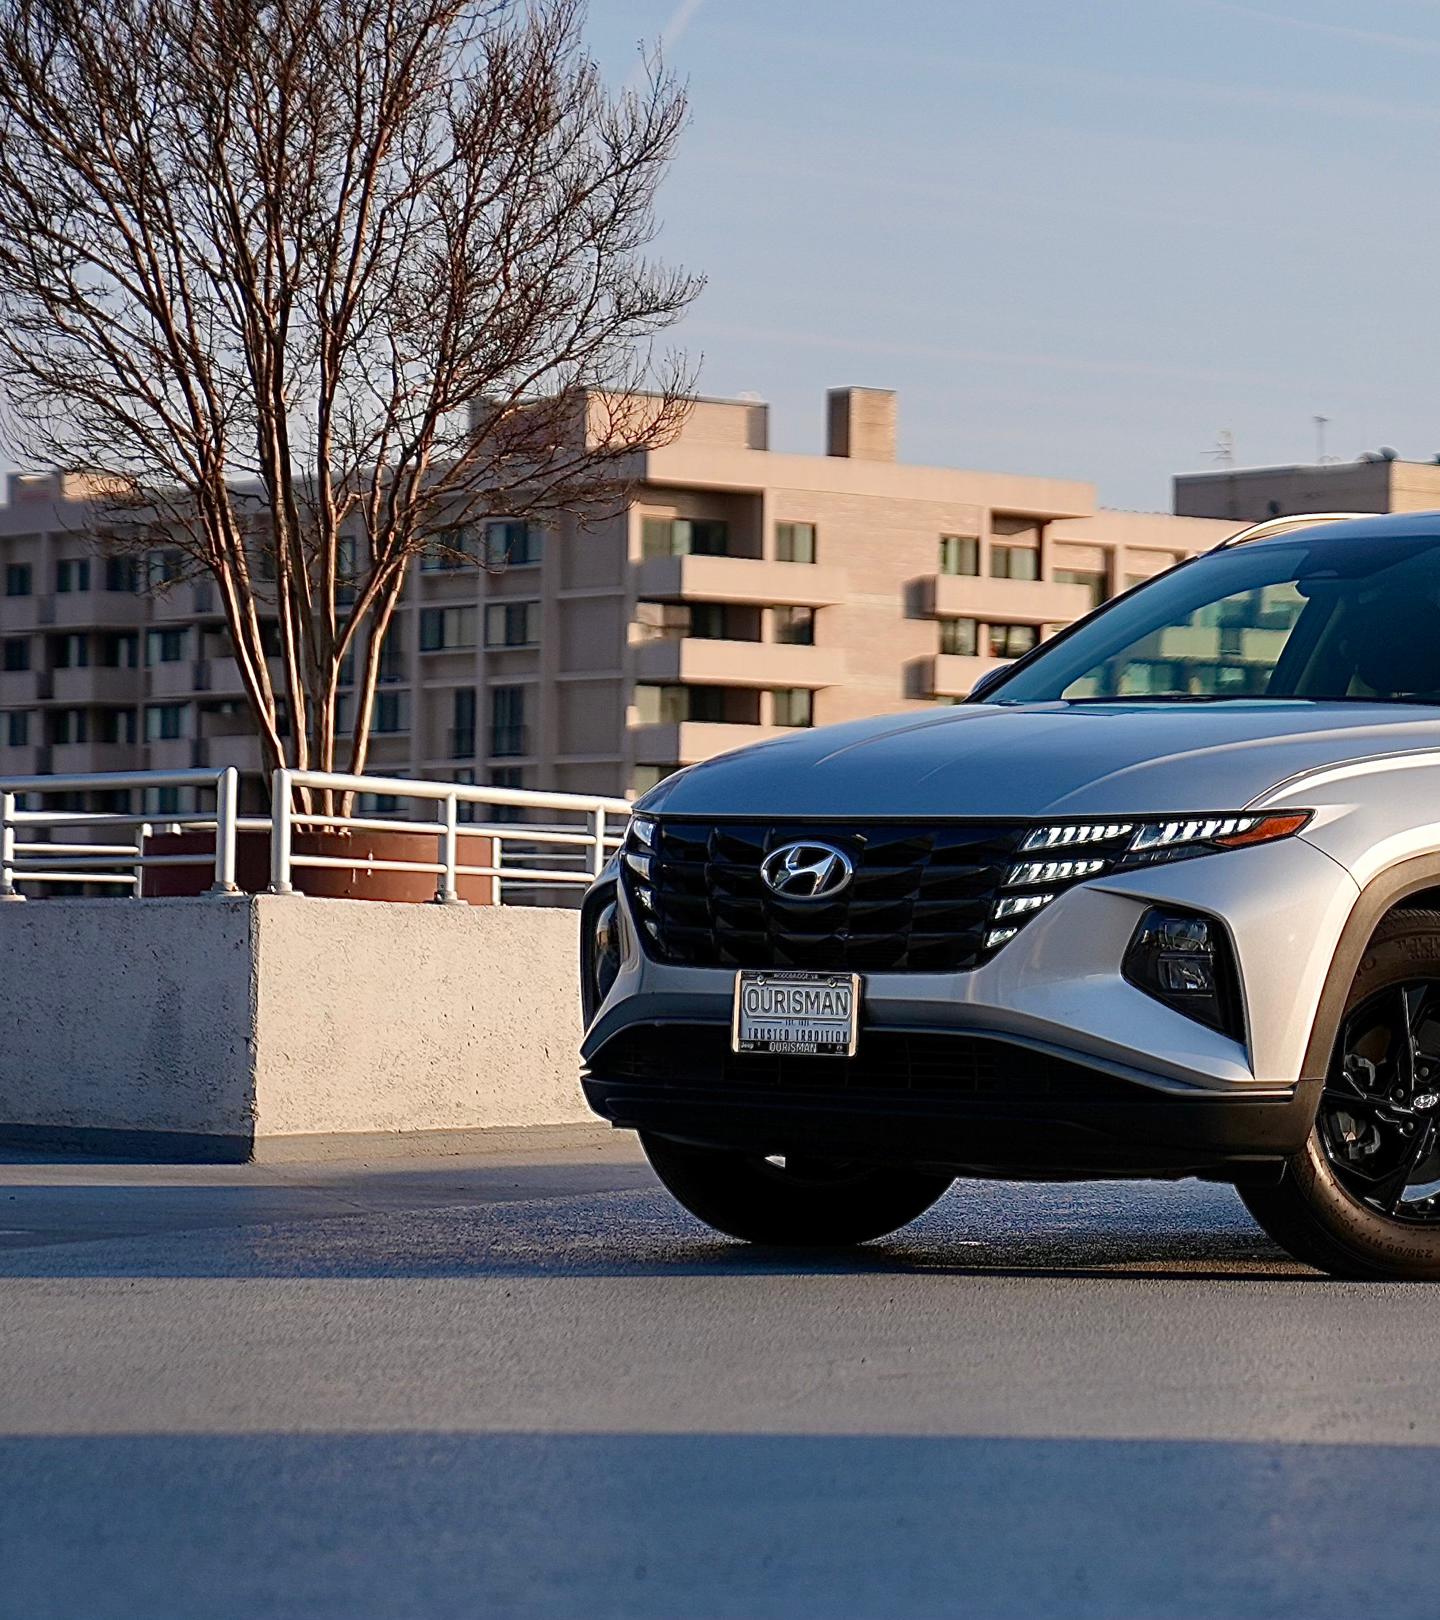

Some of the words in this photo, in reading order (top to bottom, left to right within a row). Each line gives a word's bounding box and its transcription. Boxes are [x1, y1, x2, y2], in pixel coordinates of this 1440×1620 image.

[747, 988, 848, 1015] OURISMAN
[748, 1028, 790, 1041] TRUSTED
[795, 1029, 848, 1043] TRADITION
[769, 1041, 817, 1053] OURISMAN
